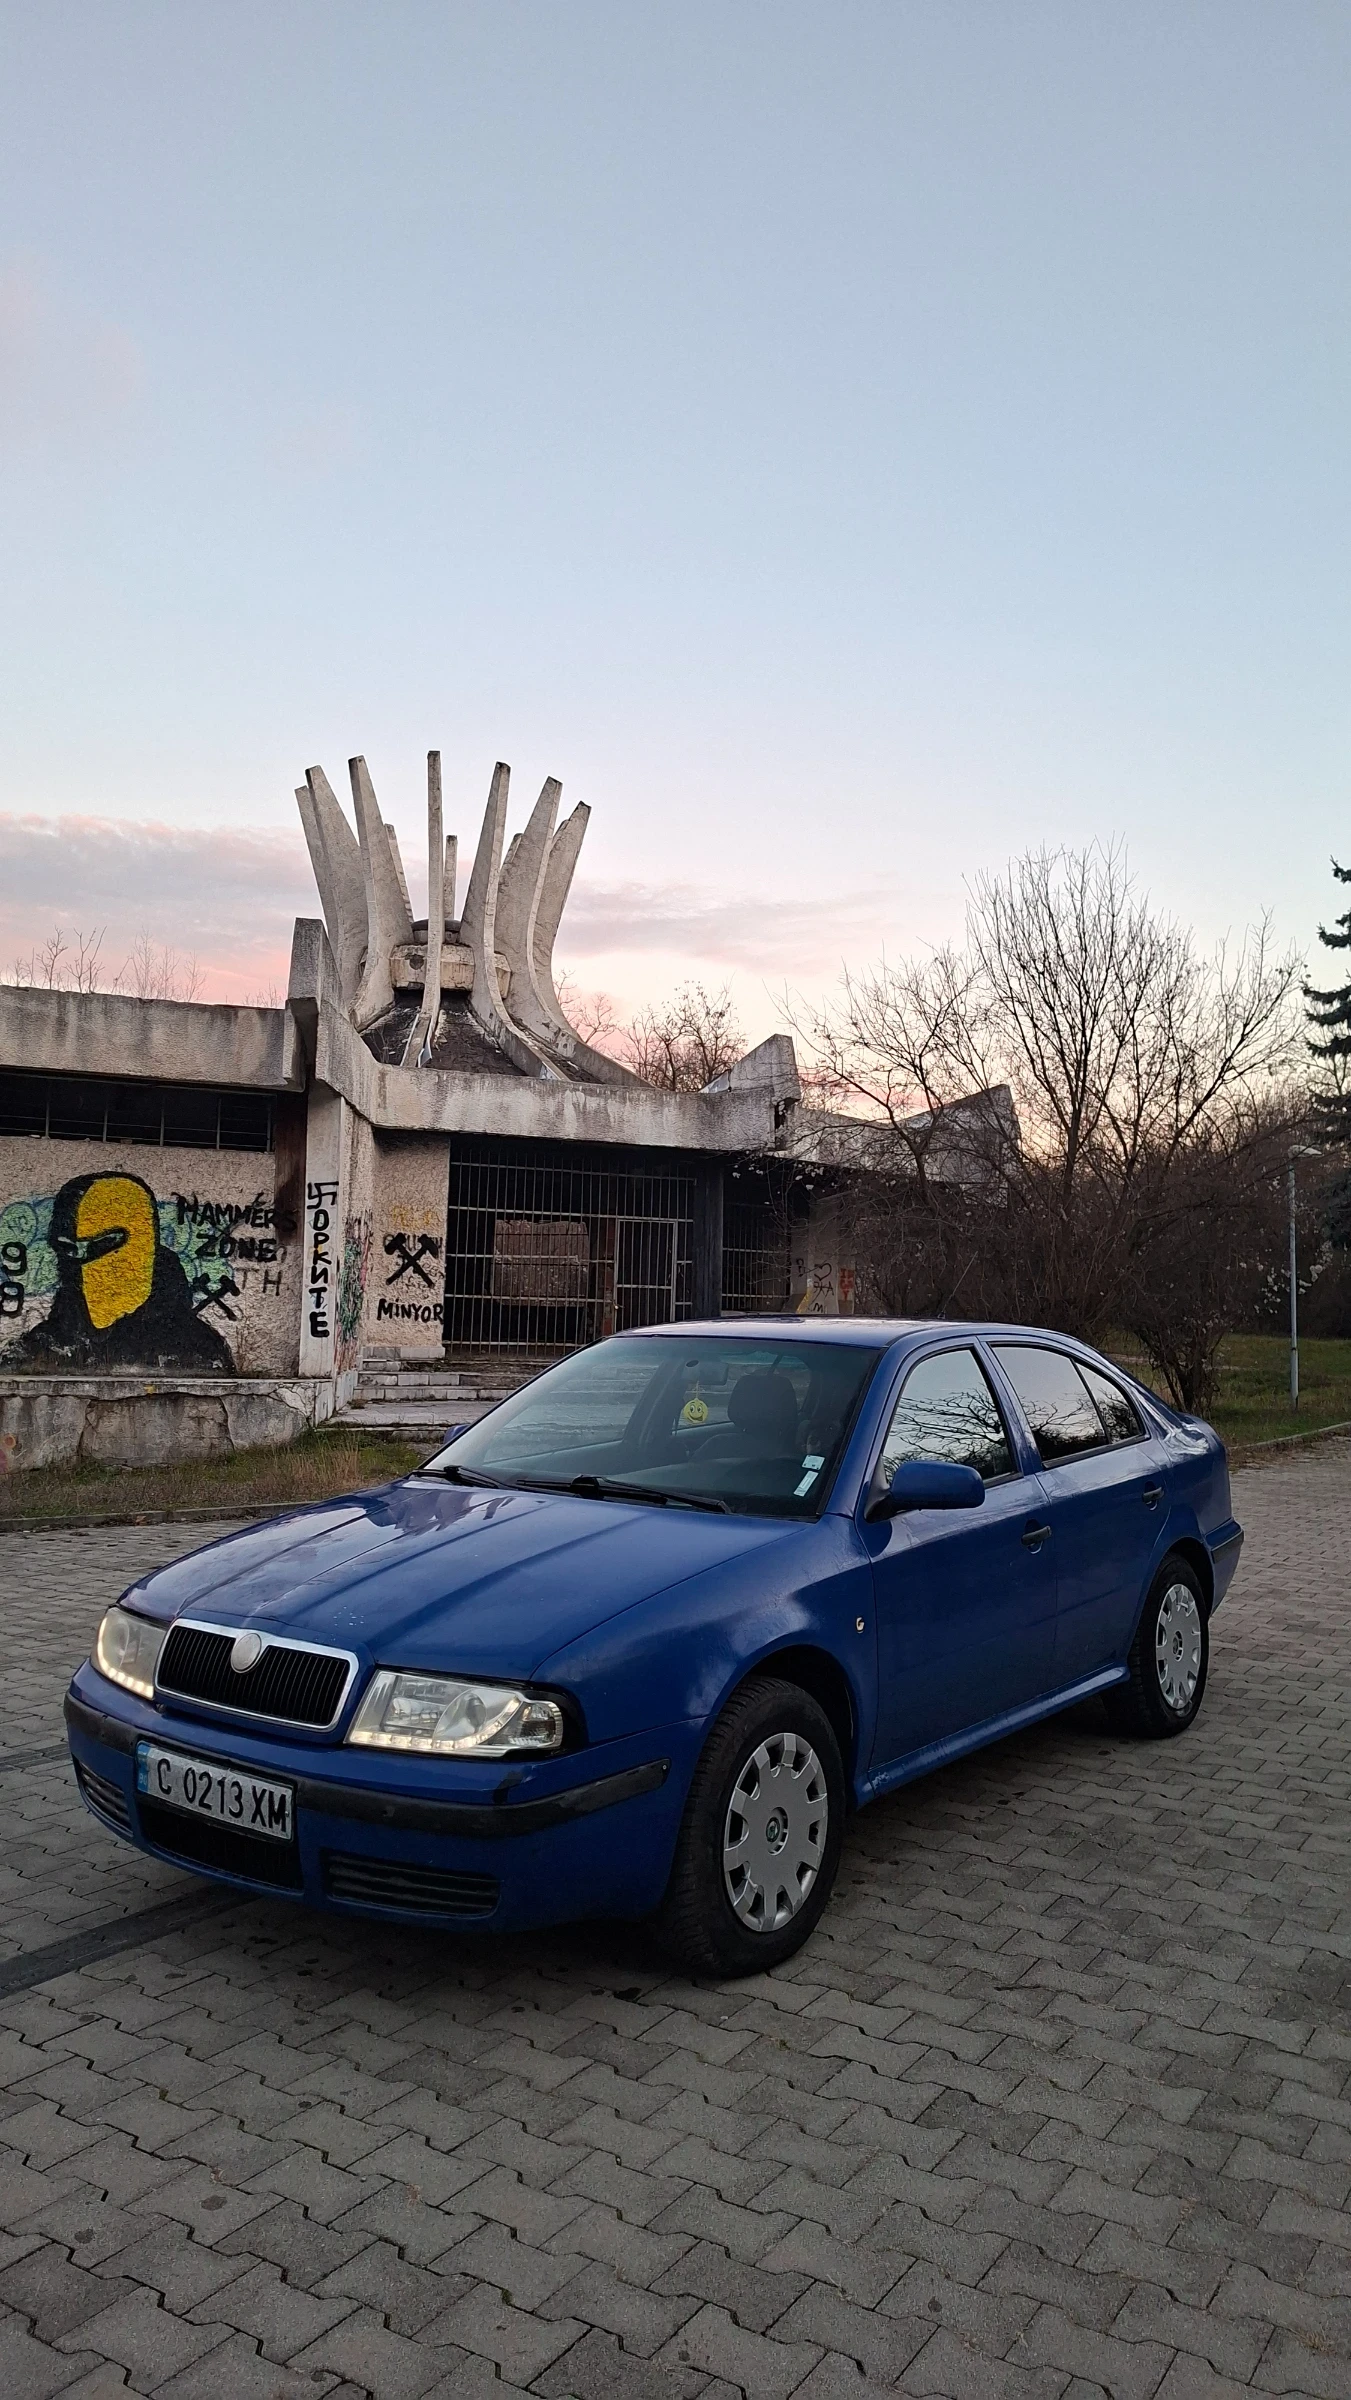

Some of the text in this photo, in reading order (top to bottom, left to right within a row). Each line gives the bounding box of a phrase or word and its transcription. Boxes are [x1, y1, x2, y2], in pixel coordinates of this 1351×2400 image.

[195, 1233, 277, 1262] ZONE
[157, 1758, 287, 1832] C 0213 XM
